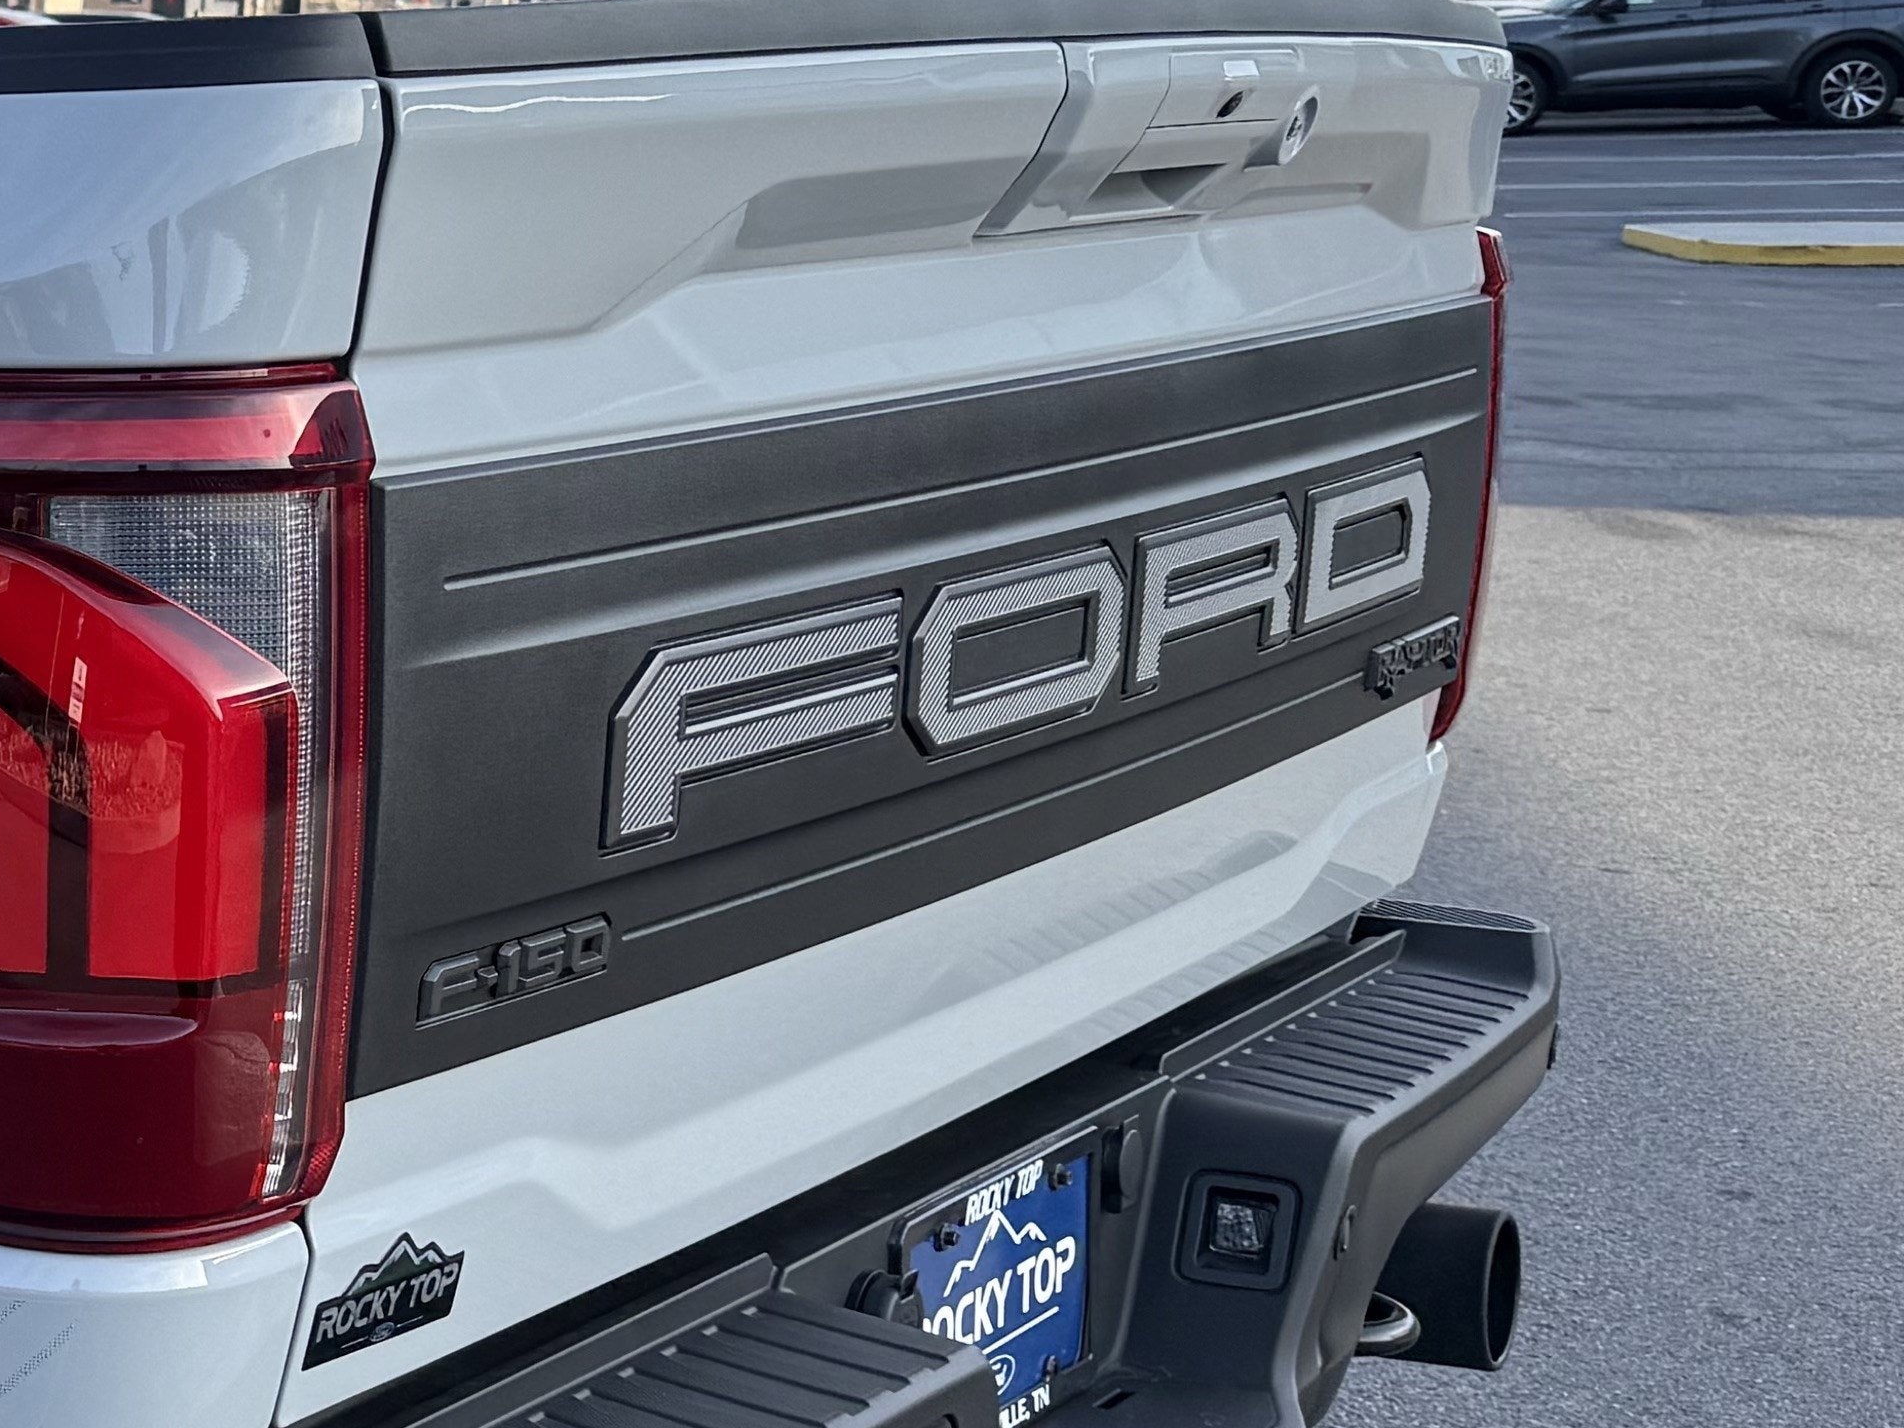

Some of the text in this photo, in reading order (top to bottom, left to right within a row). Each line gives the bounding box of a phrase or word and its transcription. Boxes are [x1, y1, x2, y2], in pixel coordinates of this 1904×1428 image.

[600, 451, 1432, 857] FORD
[415, 910, 613, 1029] F-150
[964, 1158, 1044, 1227] ROCKY TOP
[315, 1262, 460, 1344] ROCKY TOP
[922, 1235, 1076, 1345] OCKY TOP
